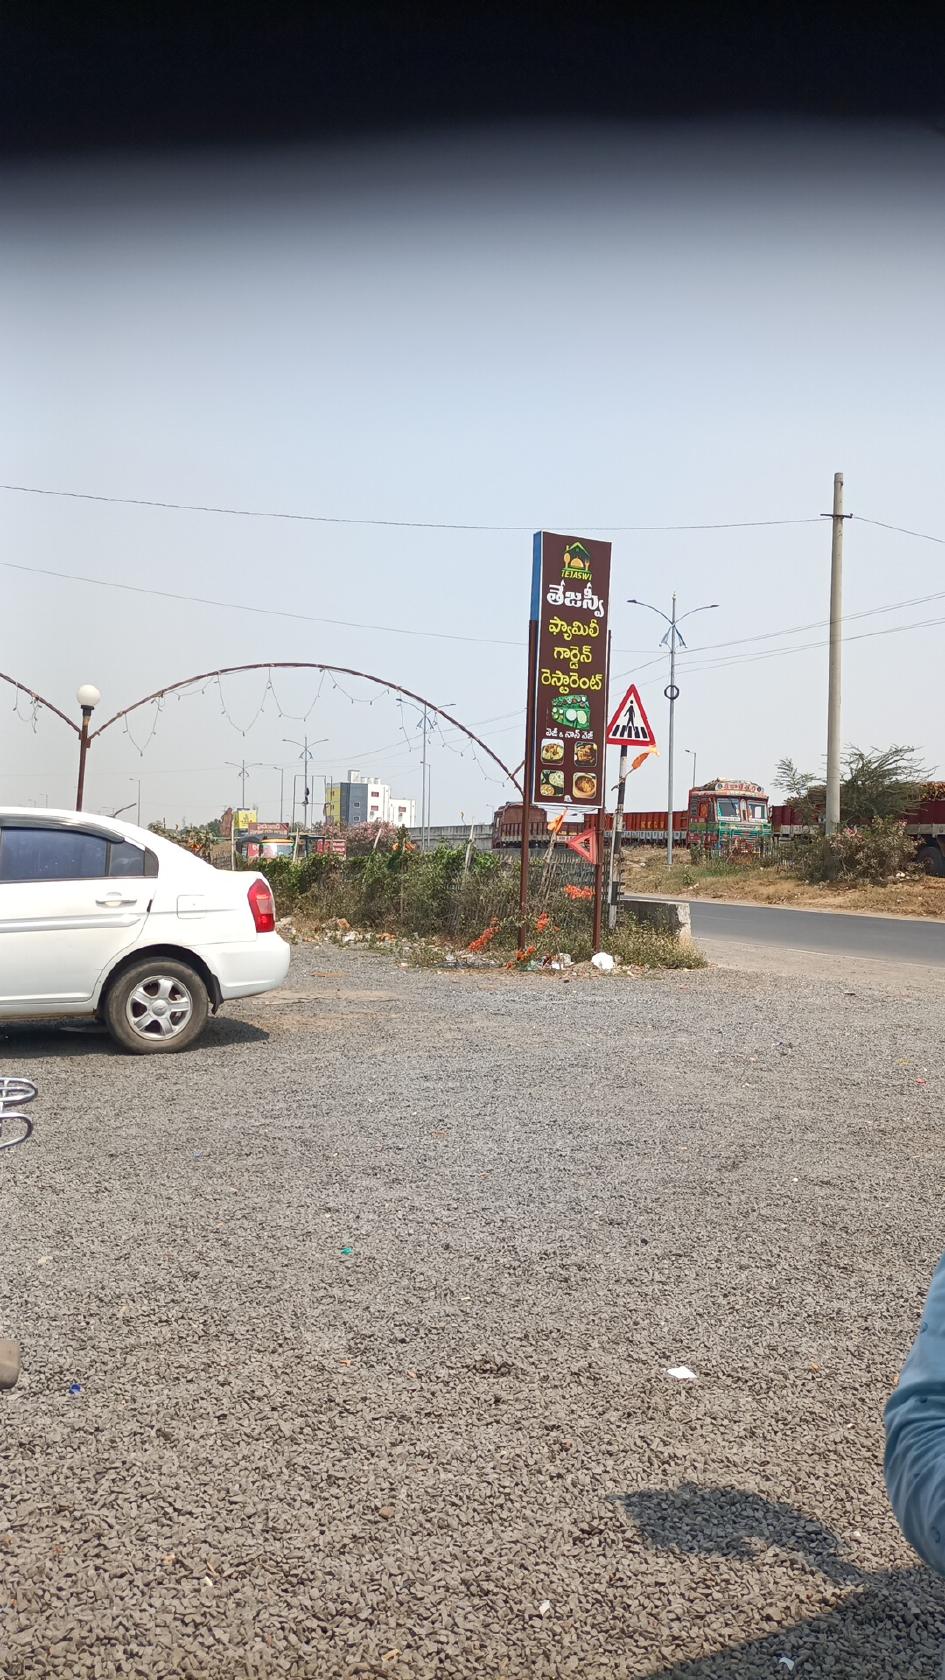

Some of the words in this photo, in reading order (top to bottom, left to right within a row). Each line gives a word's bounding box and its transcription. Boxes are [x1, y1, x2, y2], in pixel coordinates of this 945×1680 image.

[561, 570, 592, 580] TEJASWI
[546, 579, 604, 617] తేజస్వీ
[548, 616, 599, 640] ఫ్యామిలీ
[553, 645, 592, 669] గార్డెన్
[541, 669, 603, 693] రెస్టారెంట్
